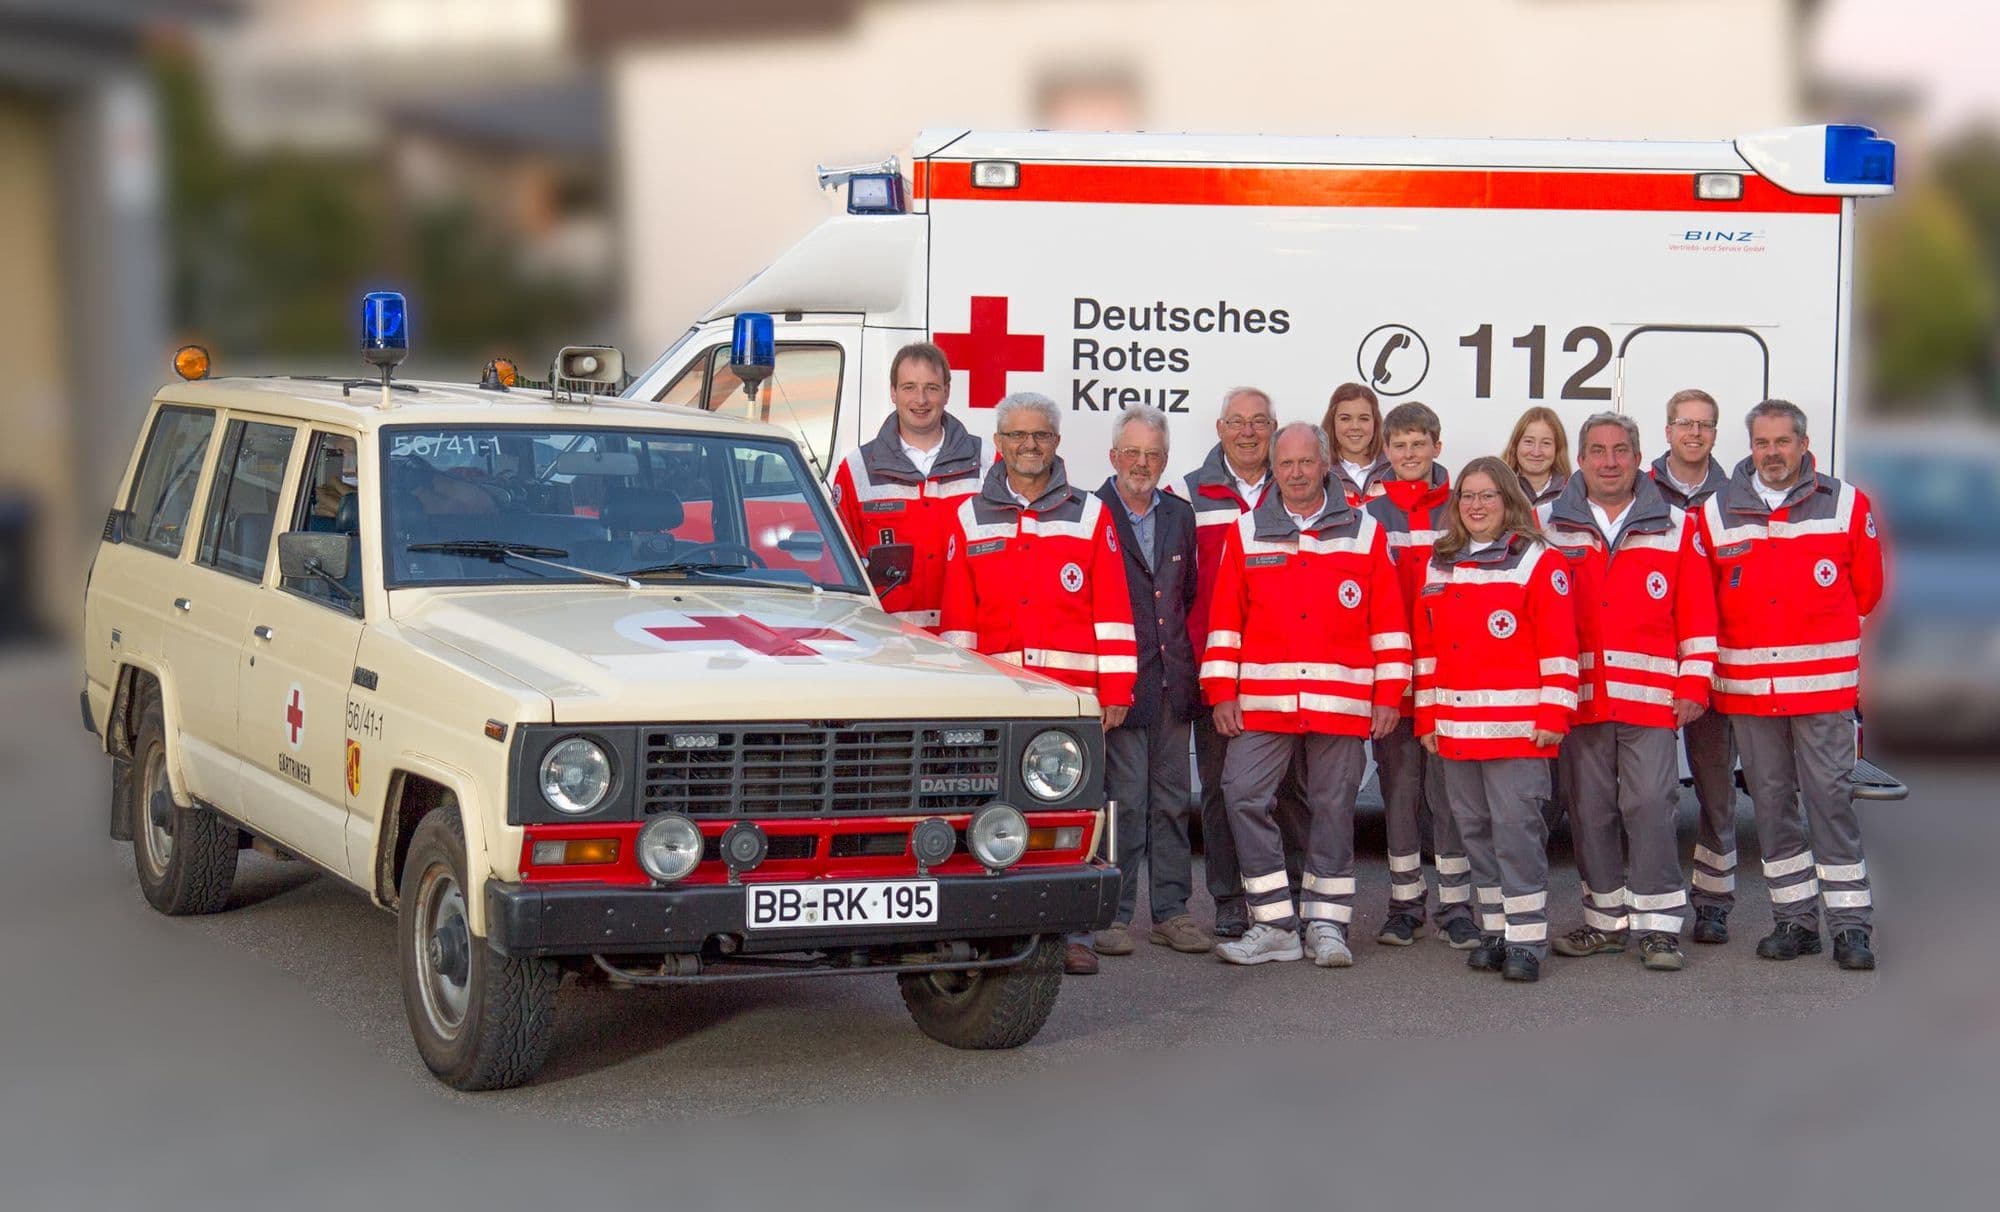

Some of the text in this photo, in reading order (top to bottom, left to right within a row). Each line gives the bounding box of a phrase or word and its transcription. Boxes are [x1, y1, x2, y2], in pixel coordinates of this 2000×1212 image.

[1685, 230, 1753, 241] BINZ
[1073, 298, 1290, 334] Deutsches
[1072, 339, 1190, 372] Rotes
[1459, 324, 1613, 400] 112
[393, 433, 501, 457] 56/41-1
[347, 701, 383, 740] 56/41-1
[921, 778, 999, 793] DATSUN
[883, 884, 933, 918] 195
